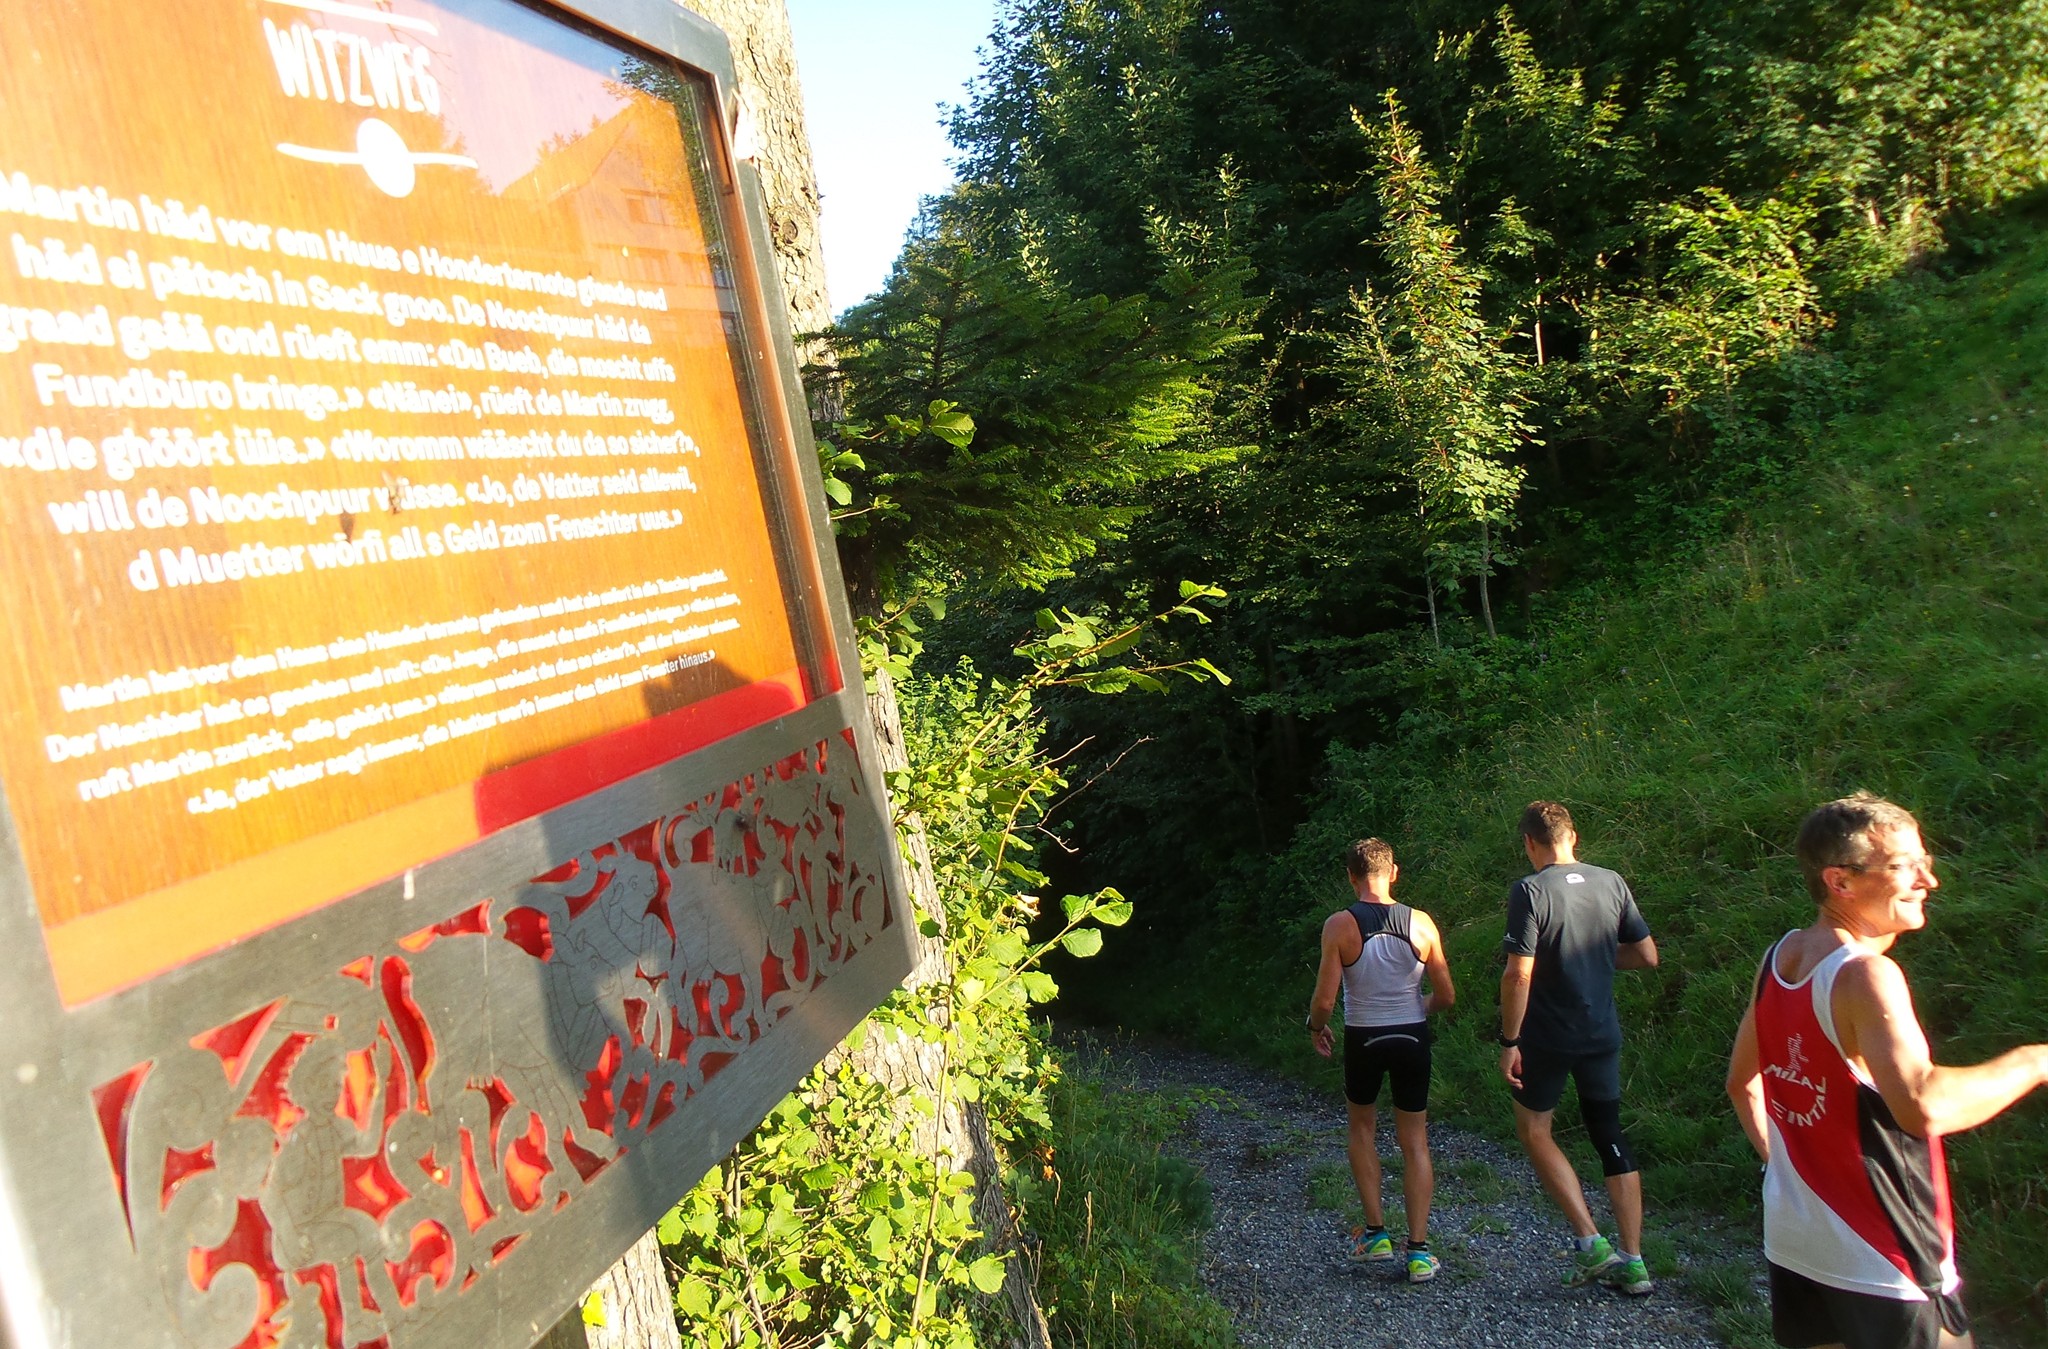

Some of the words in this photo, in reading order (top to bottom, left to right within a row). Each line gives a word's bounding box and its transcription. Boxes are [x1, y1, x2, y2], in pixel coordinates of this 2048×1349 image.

[263, 17, 441, 115] WITZWEG
[0, 171, 139, 230] Martin
[215, 217, 270, 250] vor
[276, 228, 327, 259] em
[401, 249, 419, 273] e
[272, 270, 307, 306] in
[307, 276, 383, 314] Sack
[452, 295, 485, 326] De
[214, 321, 280, 356] ond
[282, 324, 361, 361] rüeft
[546, 348, 578, 375] die
[31, 363, 232, 409] Fundbüro
[535, 388, 562, 415] de
[561, 390, 623, 415] Martin
[555, 431, 582, 456] du
[582, 430, 607, 455] da
[607, 436, 628, 454] so
[47, 489, 134, 533] will
[136, 488, 188, 527] de
[189, 483, 370, 523] Noochpuur
[512, 473, 540, 501] de
[538, 472, 599, 498] Vatter
[128, 550, 158, 590] d
[159, 542, 304, 586] Muetter
[388, 526, 425, 559] all
[425, 532, 443, 555] s
[443, 520, 499, 552] Geld
[500, 522, 547, 546] zom
[546, 510, 637, 540] Fenschter
[44, 733, 97, 761] Der
[78, 767, 132, 800] ruft
